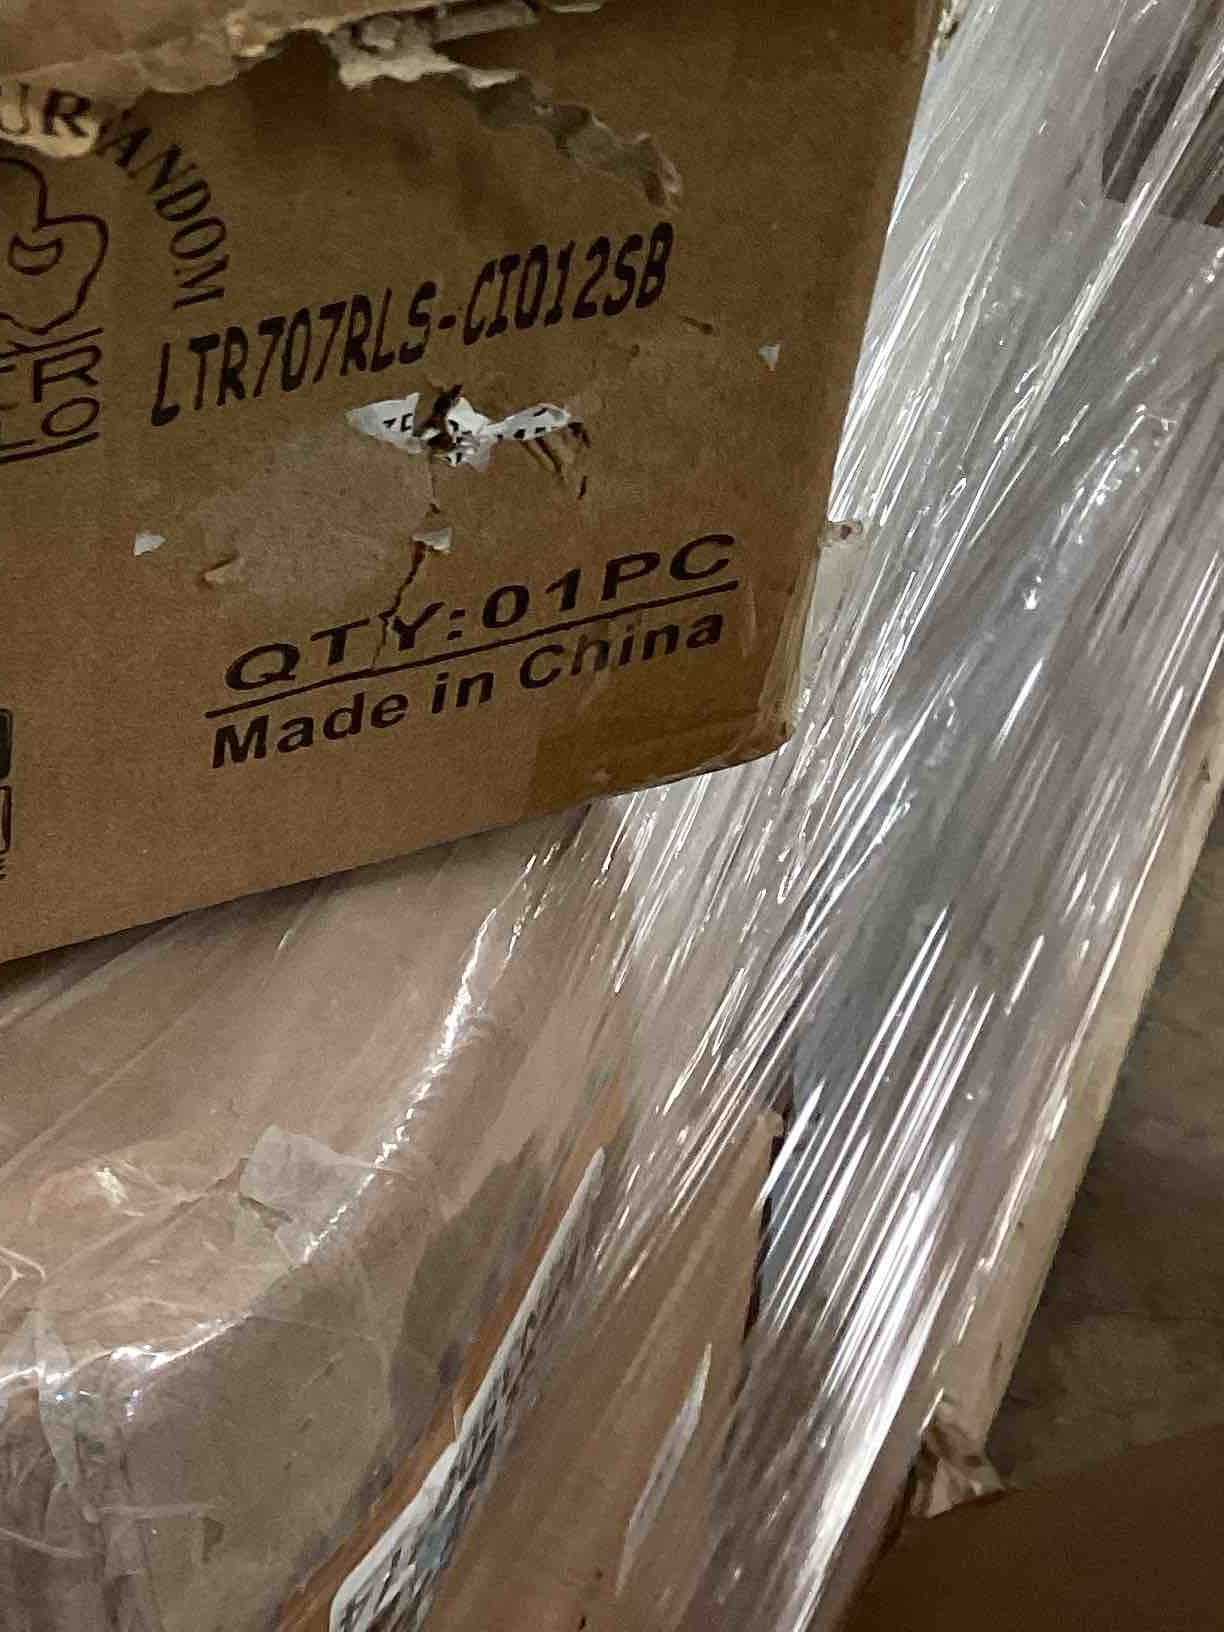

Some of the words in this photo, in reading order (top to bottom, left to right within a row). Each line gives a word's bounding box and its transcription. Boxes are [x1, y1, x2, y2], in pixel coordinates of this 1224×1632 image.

[212, 691, 409, 768] Made
[431, 670, 493, 714] in
[520, 611, 724, 689] China
